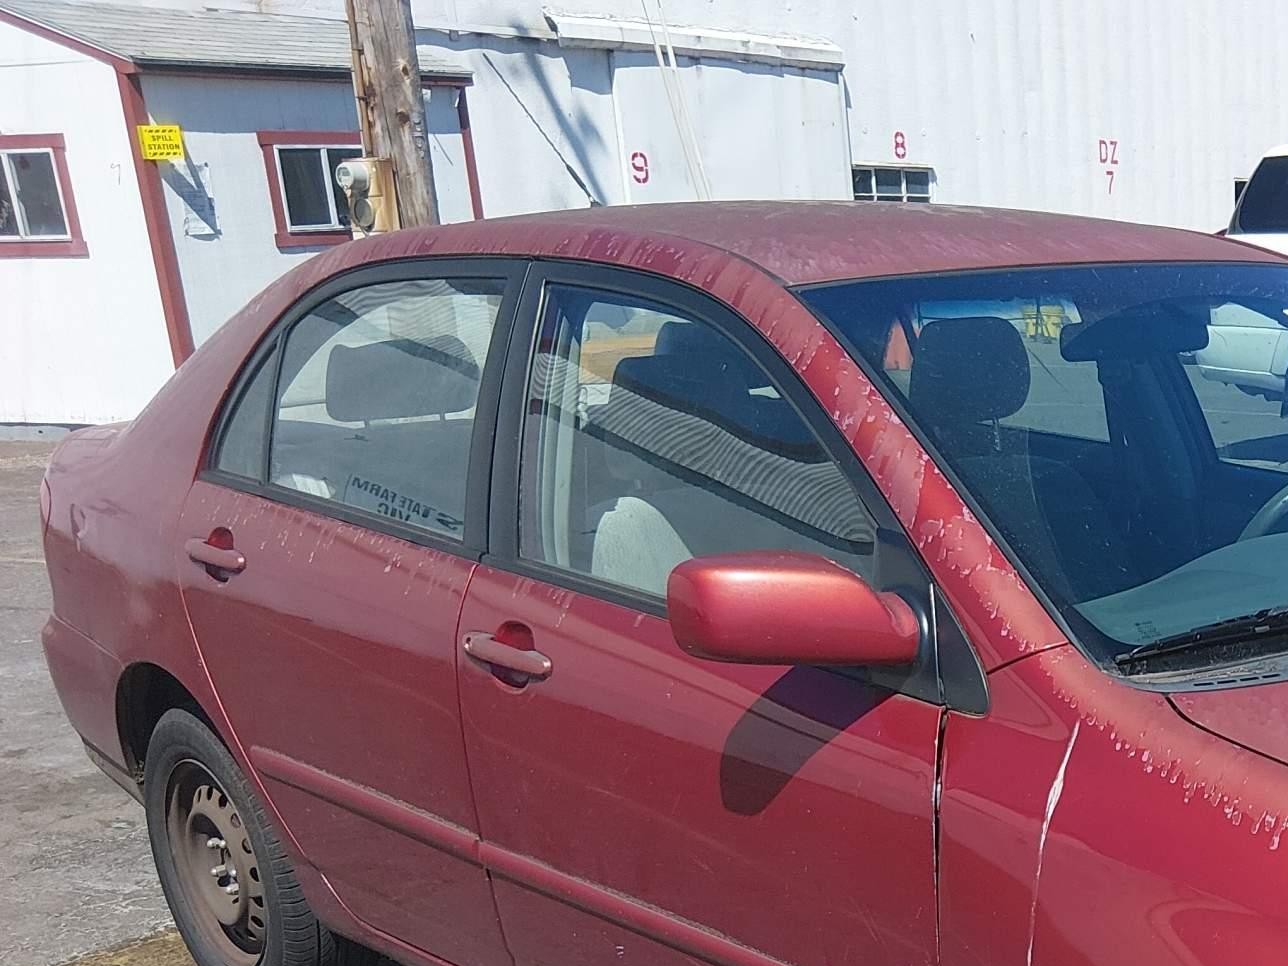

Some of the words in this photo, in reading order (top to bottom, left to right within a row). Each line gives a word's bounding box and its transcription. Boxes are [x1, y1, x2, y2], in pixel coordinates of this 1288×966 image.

[147, 143, 180, 151] STATION
[894, 131, 906, 159] 8
[1099, 139, 1118, 164] DZ
[631, 151, 649, 184] 9
[1105, 170, 1114, 194] 7
